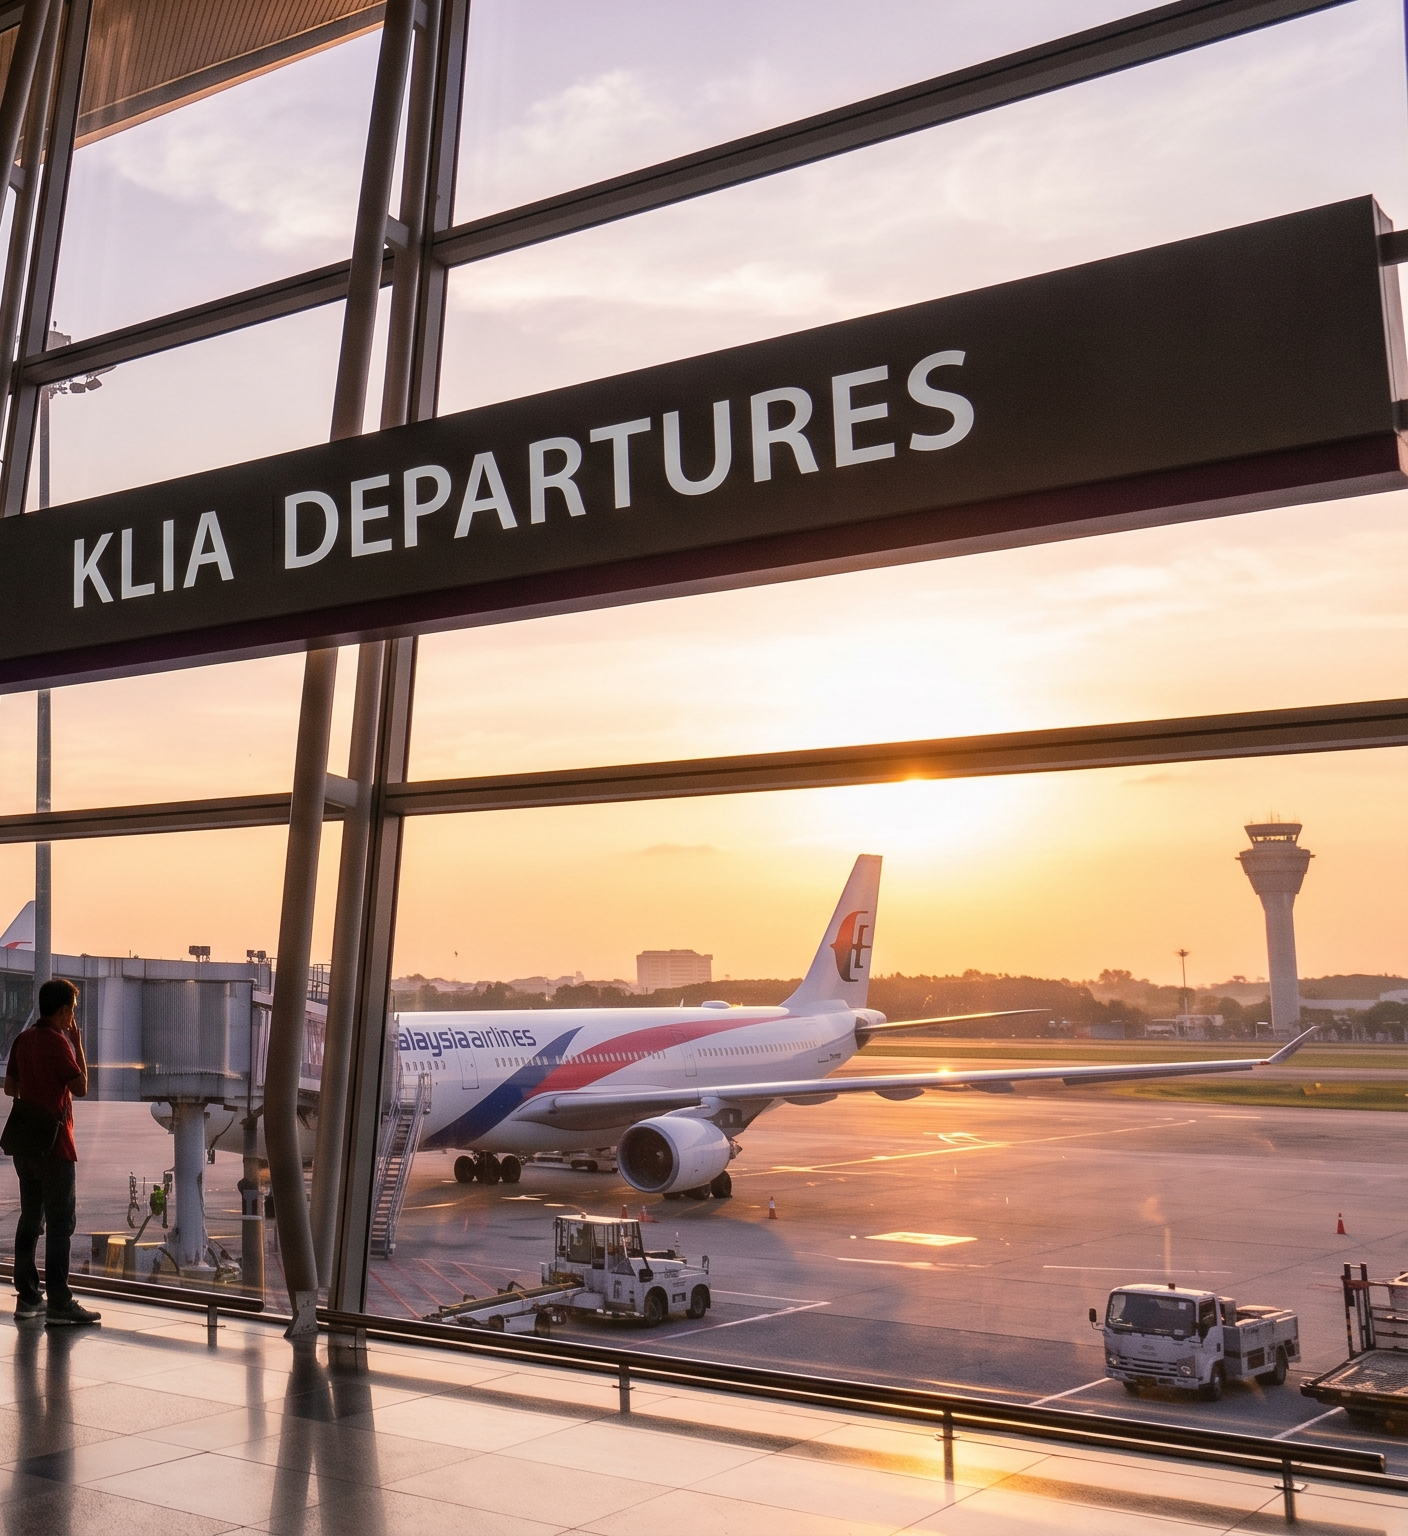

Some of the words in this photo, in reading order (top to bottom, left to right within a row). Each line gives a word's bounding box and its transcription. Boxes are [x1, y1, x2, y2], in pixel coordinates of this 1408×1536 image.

[72, 510, 236, 610] KLIA
[283, 348, 976, 571] DEPARTURES
[398, 1027, 471, 1057] alaysia
